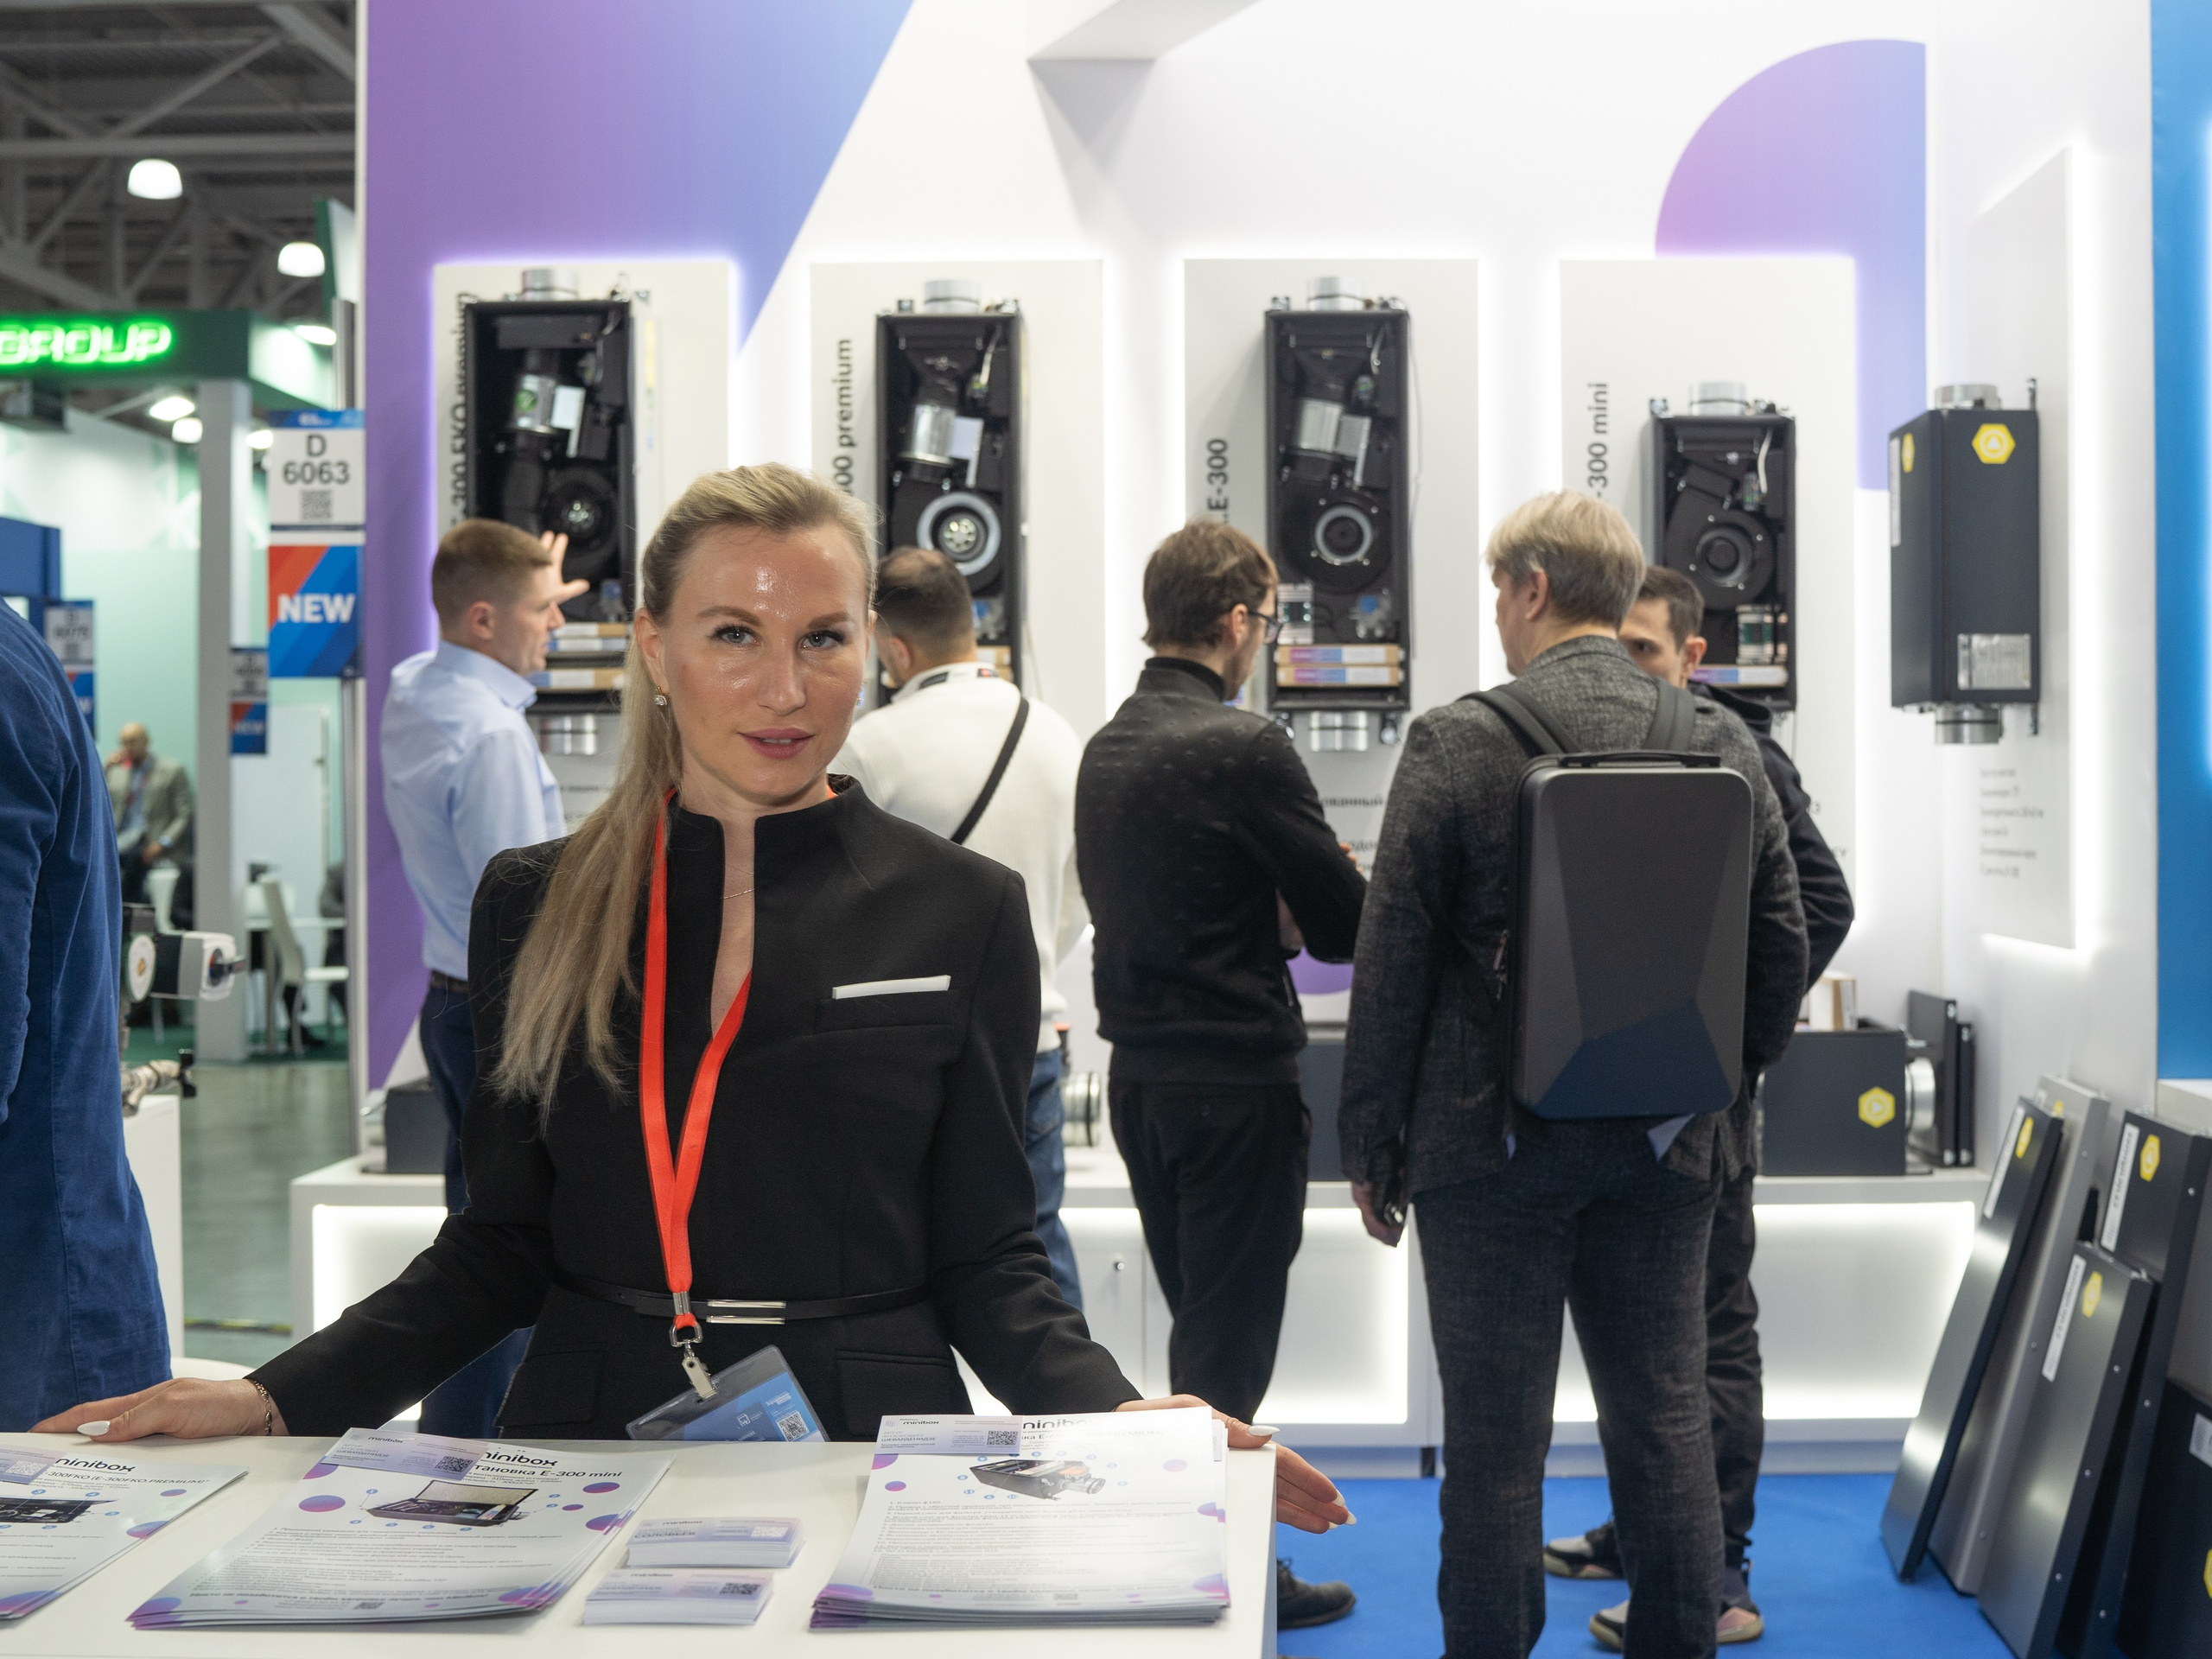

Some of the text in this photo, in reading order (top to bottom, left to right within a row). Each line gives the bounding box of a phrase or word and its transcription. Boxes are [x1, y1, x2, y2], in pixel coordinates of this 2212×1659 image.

[831, 339, 857, 448] premium
[1588, 383, 1607, 435] mini
[307, 434, 327, 457] D
[283, 461, 349, 485] 6063
[278, 594, 355, 623] NEW
